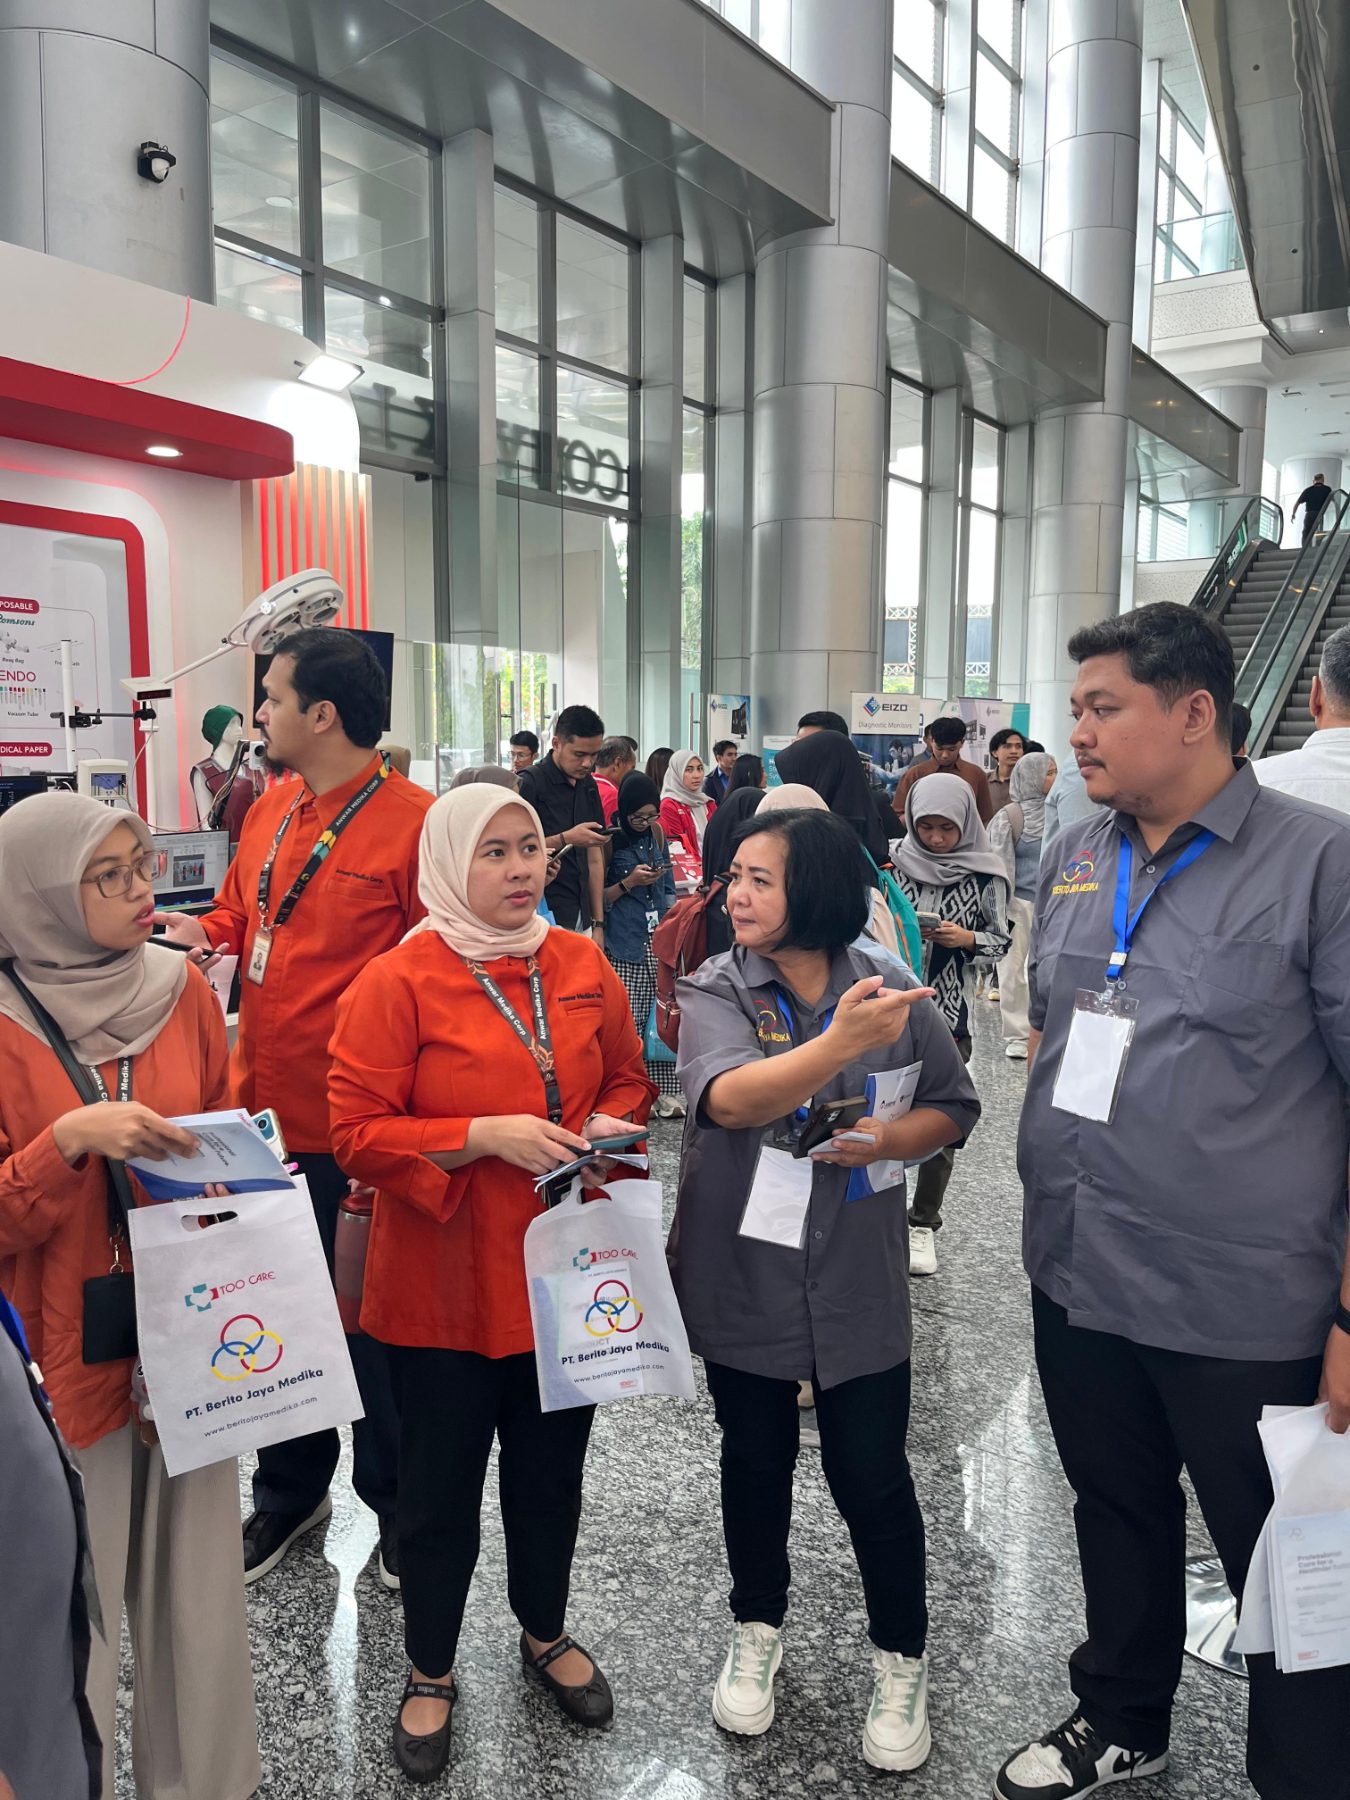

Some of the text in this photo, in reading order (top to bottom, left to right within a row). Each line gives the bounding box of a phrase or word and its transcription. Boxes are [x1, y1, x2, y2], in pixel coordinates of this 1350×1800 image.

[858, 721, 887, 730] Diagnostic
[24, 745, 48, 753] PAPER
[336, 780, 378, 826] ANWAR MEDIKA CORP
[482, 977, 526, 1036] Anwar Medika Corp
[536, 994, 544, 1018] Medika
[539, 1018, 547, 1040] Anwar
[121, 1060, 129, 1091] Medika
[598, 1249, 619, 1260] TOO
[219, 1271, 276, 1296] TOO CARE
[561, 1341, 670, 1365] PT. Berito Jaya Medika
[185, 1367, 324, 1420] PT. Berito Jaya Medika
[203, 1396, 318, 1438] www.beritojayamedika.com
